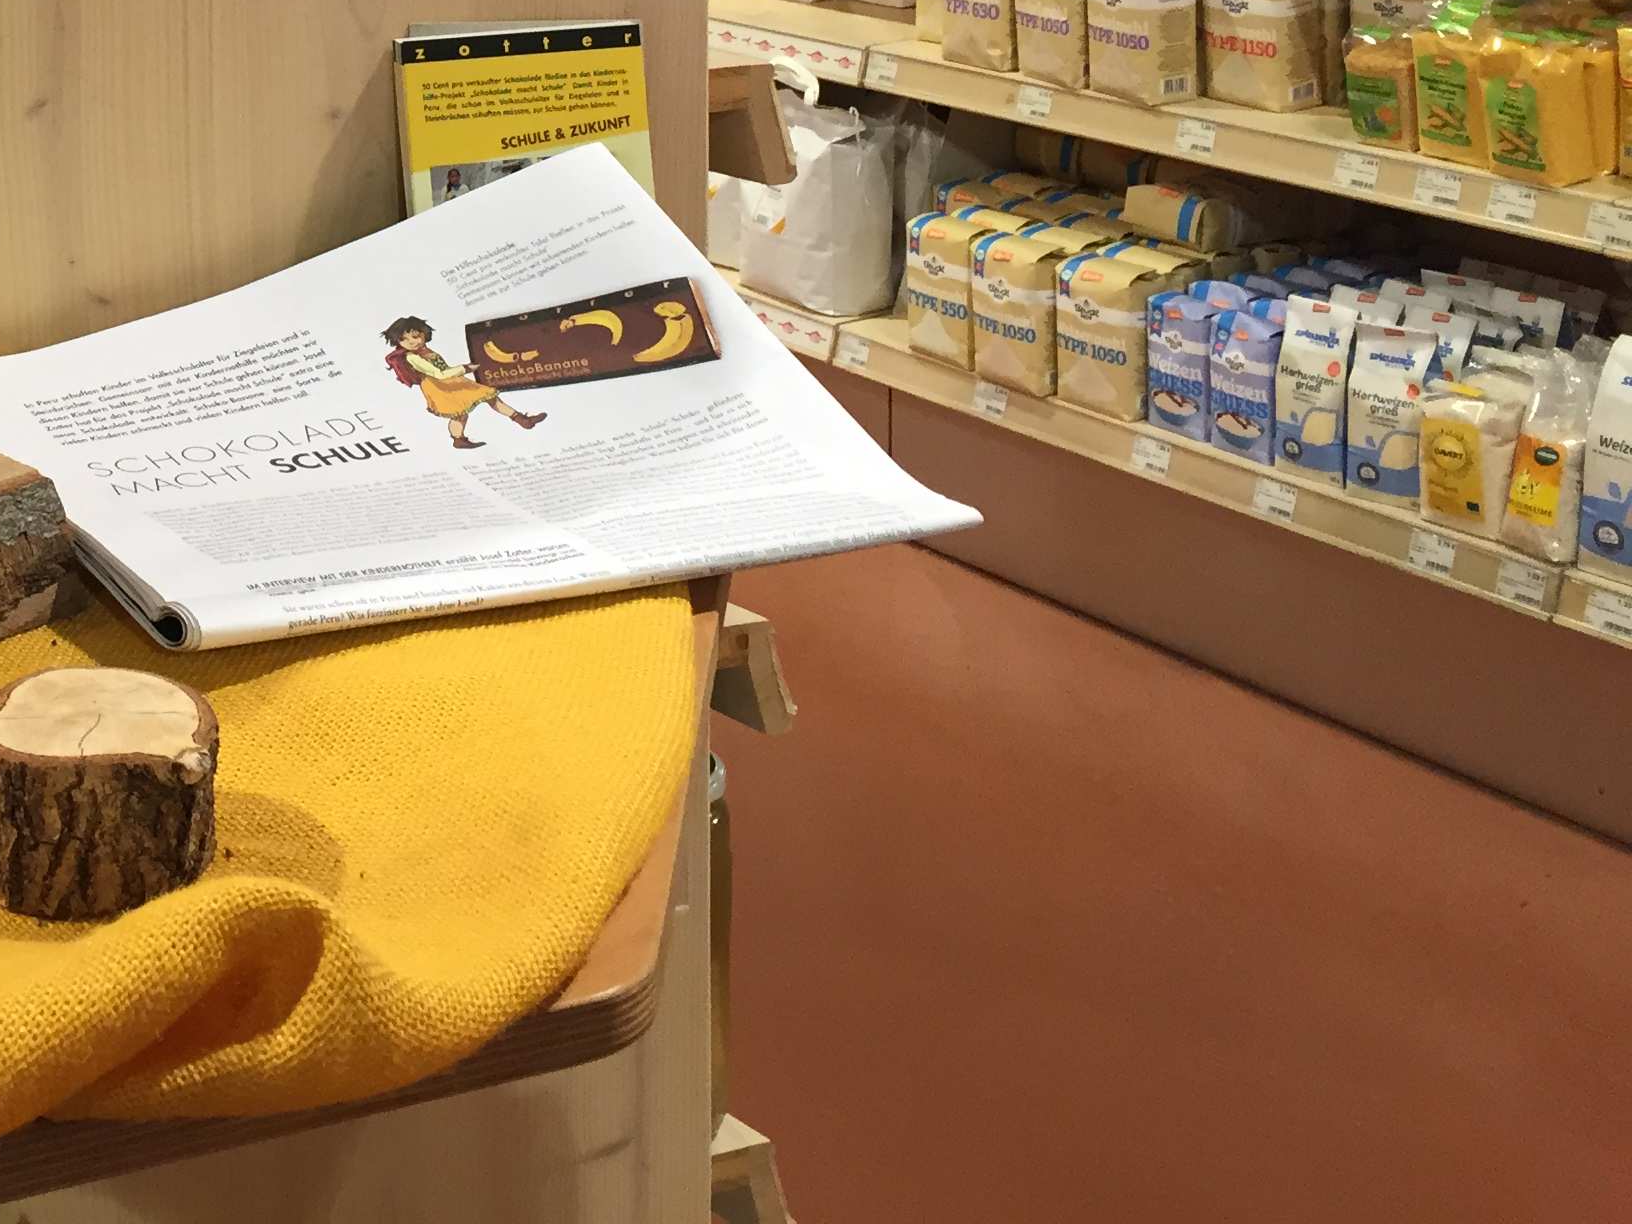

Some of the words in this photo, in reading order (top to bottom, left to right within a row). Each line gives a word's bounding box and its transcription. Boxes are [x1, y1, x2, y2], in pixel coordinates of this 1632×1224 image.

[1040, 17, 1070, 36] 1050
[1116, 33, 1150, 50] 1050
[501, 129, 551, 150] SCHULE
[555, 127, 566, 140] &
[570, 115, 631, 138] ZUKUNFT
[941, 299, 968, 320] 550
[1001, 322, 1036, 344] 1050
[1091, 343, 1127, 367] 1050
[484, 357, 589, 381] SchokoBanane
[87, 410, 384, 478] SCHOKOLADE
[110, 464, 252, 495] MACHT
[268, 436, 410, 474] SCHULE
